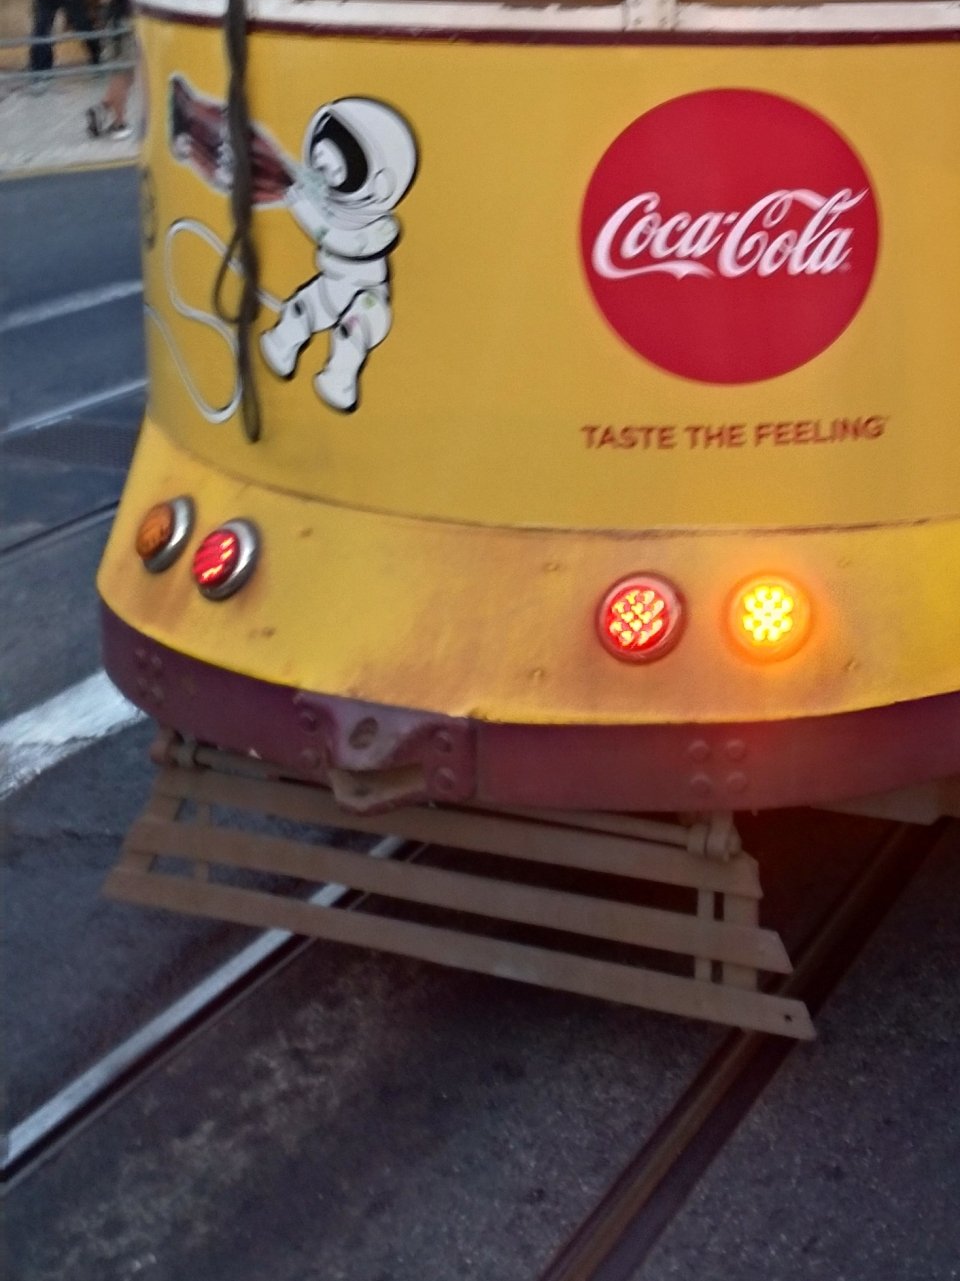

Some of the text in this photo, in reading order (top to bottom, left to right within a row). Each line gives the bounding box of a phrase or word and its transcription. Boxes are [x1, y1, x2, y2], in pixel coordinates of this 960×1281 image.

[592, 187, 869, 281] Coca-Cola
[581, 414, 890, 450] TASTE THE FEELING
